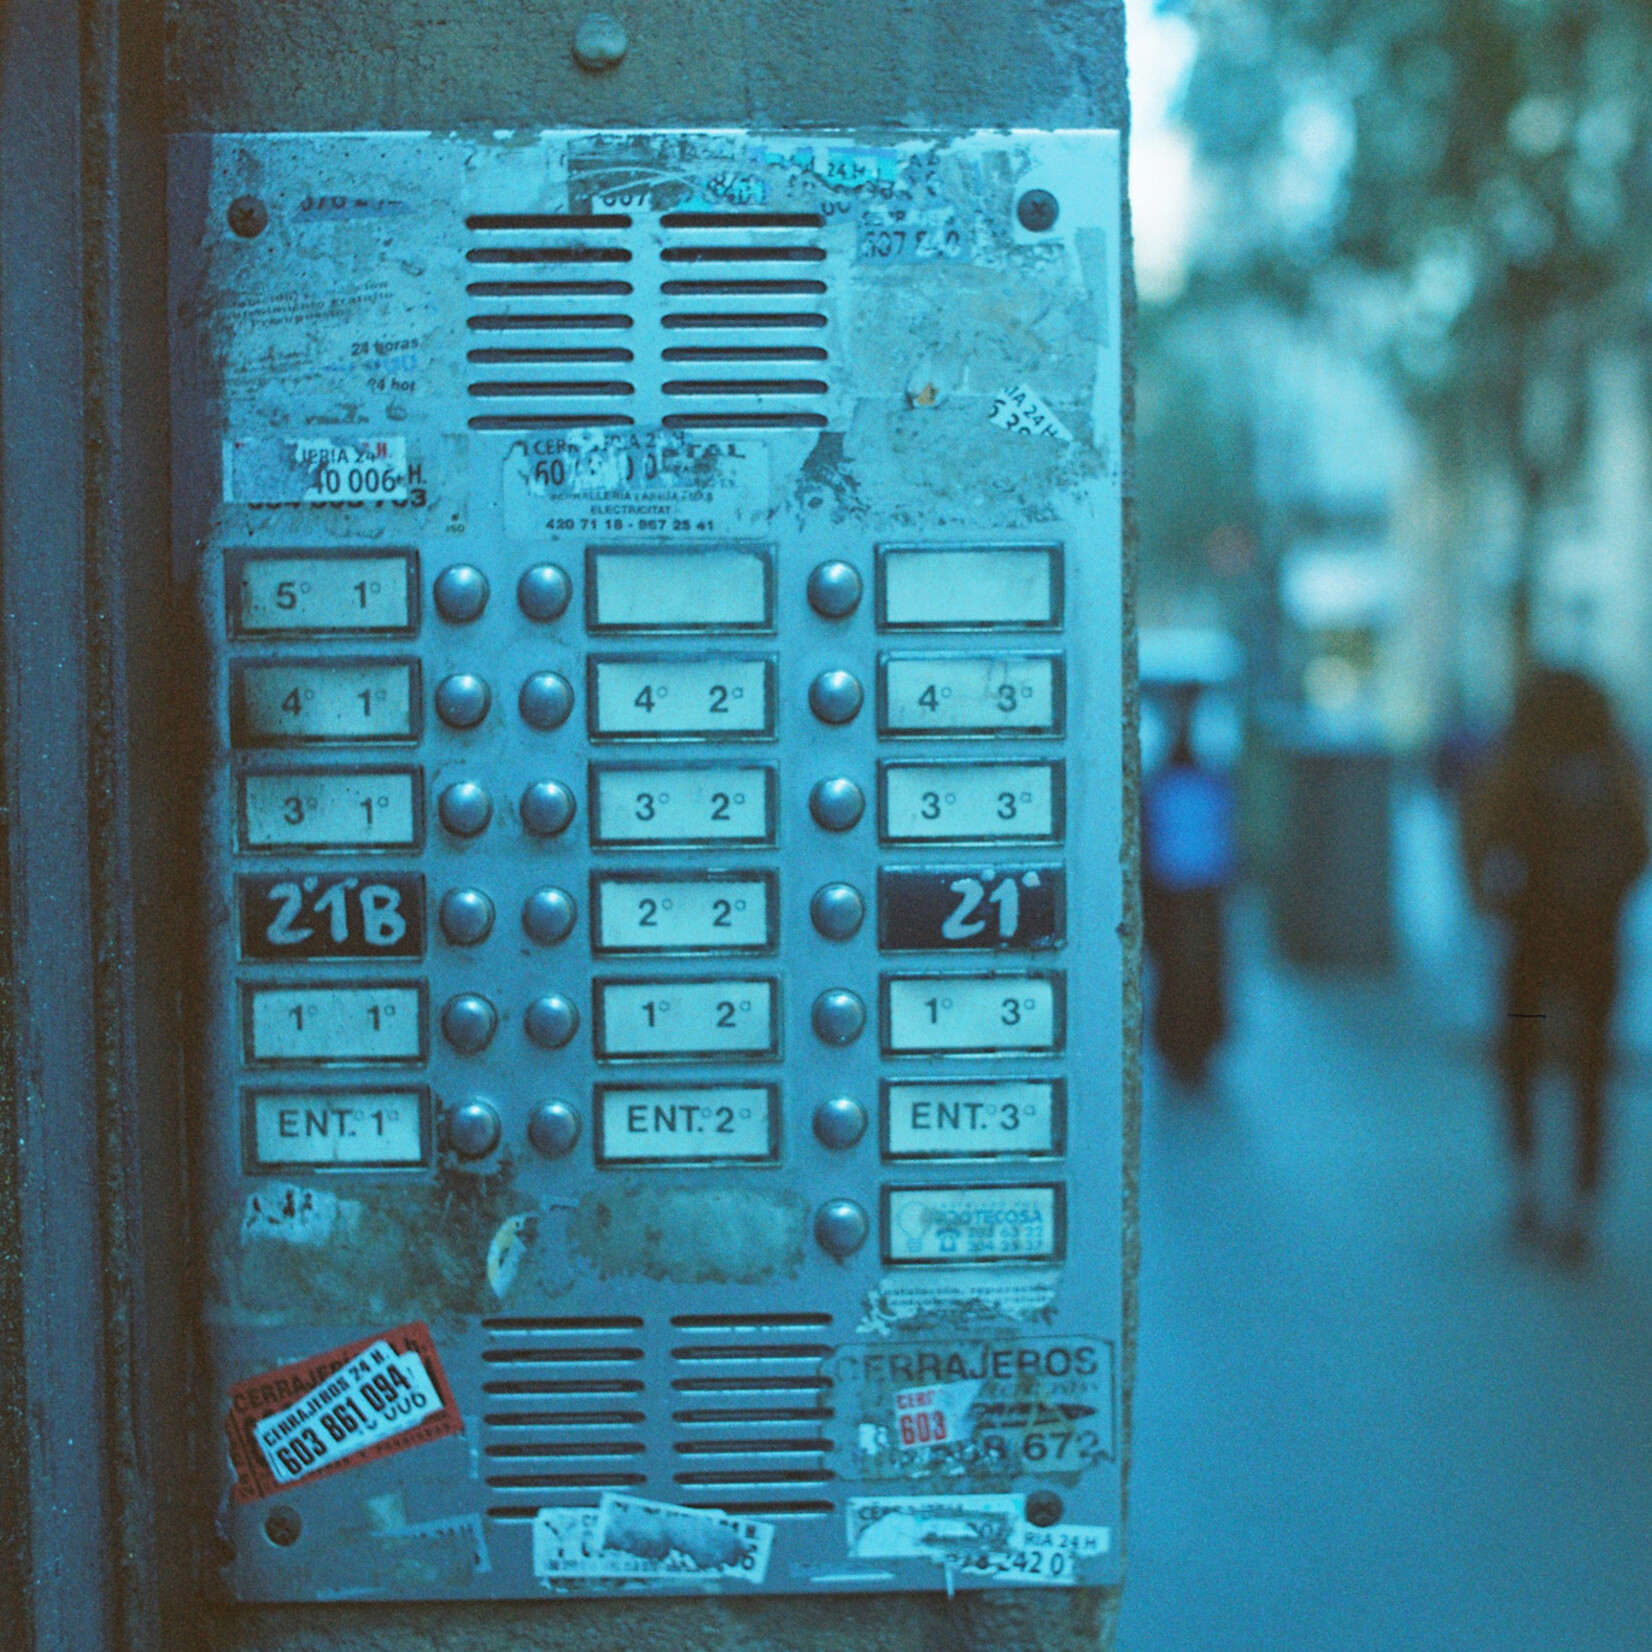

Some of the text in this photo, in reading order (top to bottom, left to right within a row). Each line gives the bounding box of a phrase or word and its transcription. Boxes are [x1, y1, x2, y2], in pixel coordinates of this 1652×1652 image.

[546, 518, 574, 530] 420
[581, 518, 597, 530] 71
[348, 1360, 372, 1382] 24
[277, 1427, 327, 1476] 603
[319, 1396, 368, 1443] 861
[360, 1363, 412, 1413] 094
